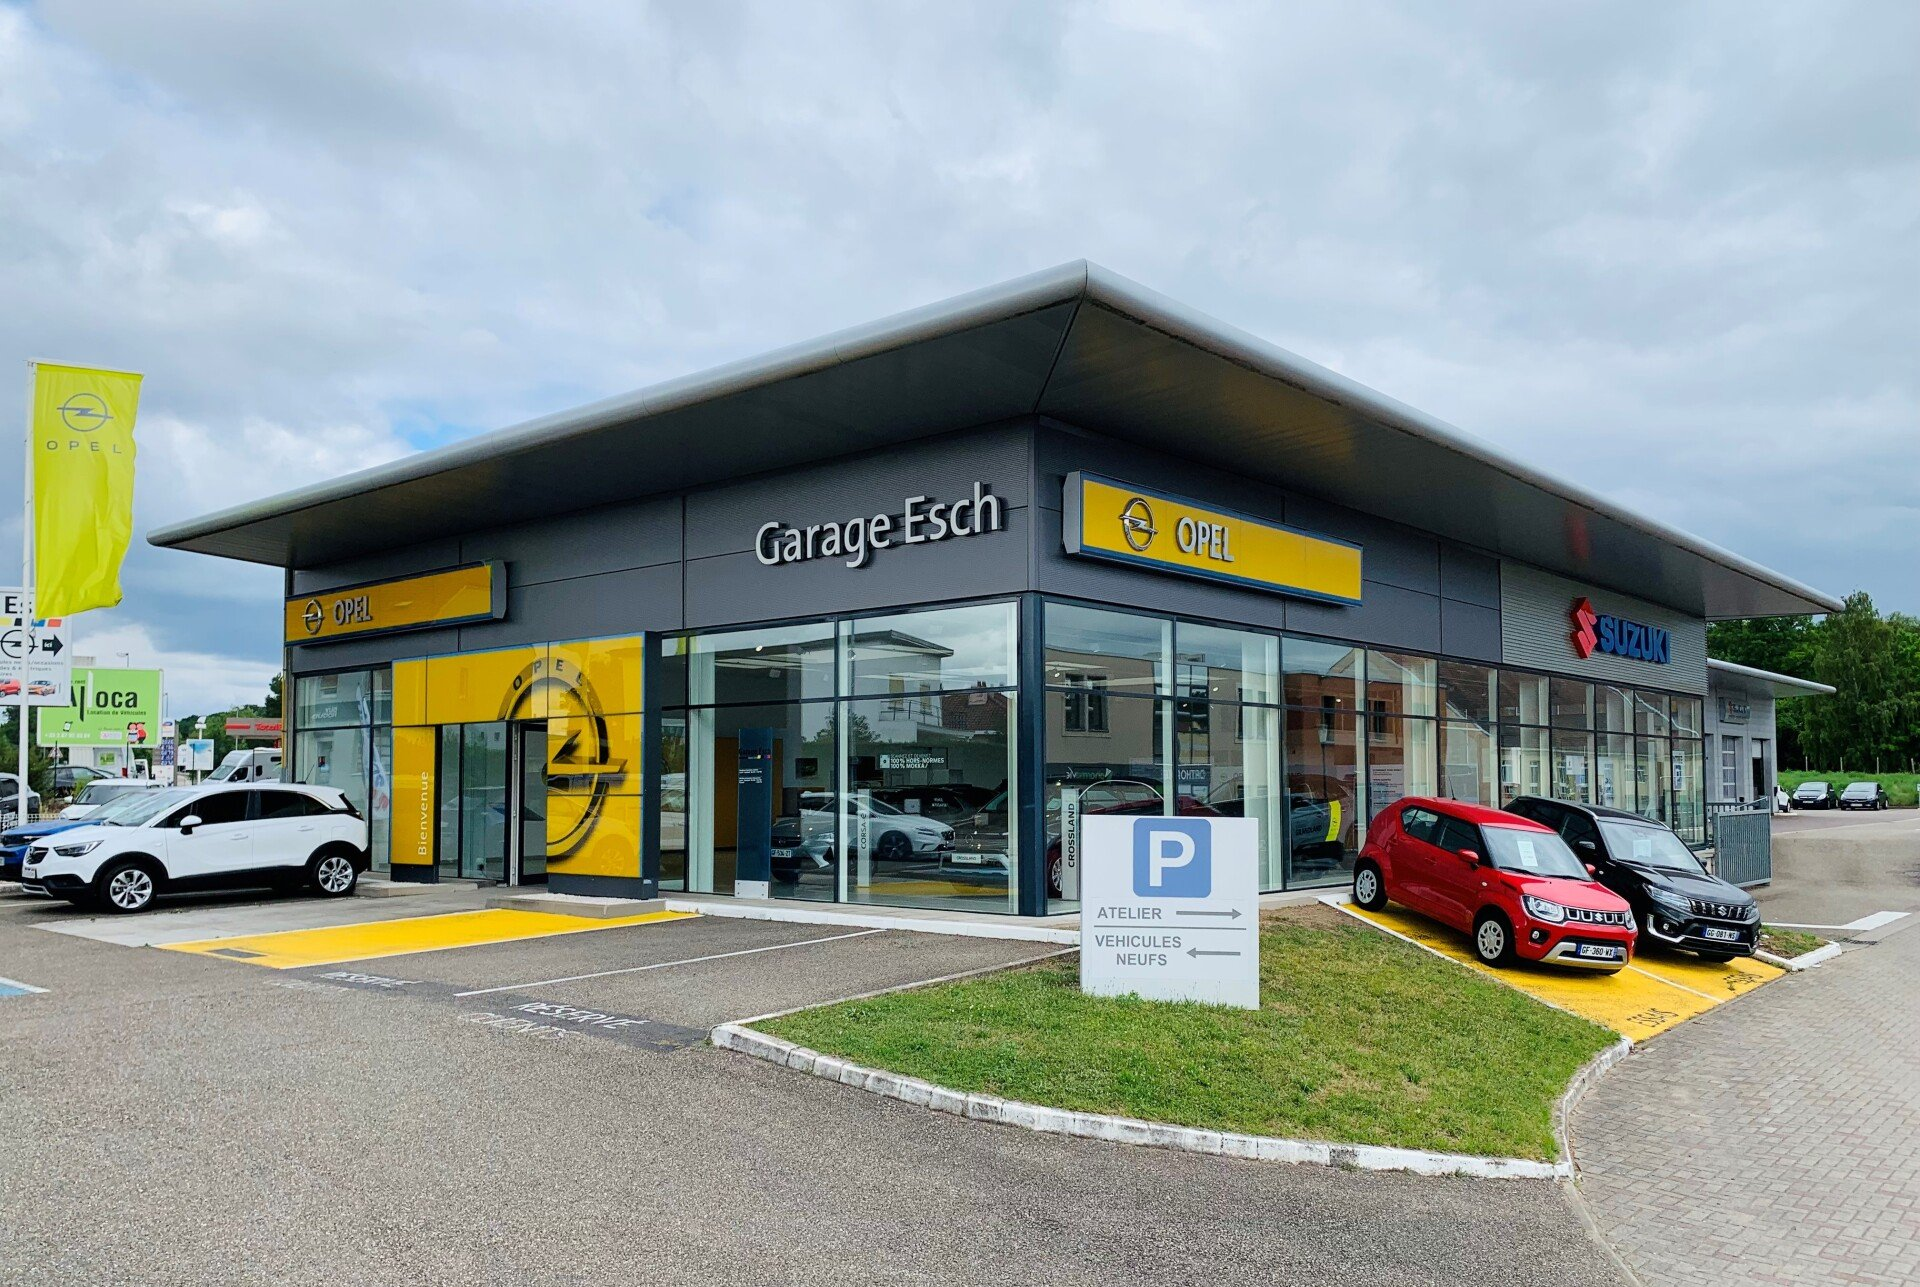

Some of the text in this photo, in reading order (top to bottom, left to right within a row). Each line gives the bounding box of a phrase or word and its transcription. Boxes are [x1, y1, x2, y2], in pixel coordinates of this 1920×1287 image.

[47, 440, 122, 454] OPEL
[755, 481, 1000, 568] Garage Esch
[1176, 515, 1235, 562] OPEL
[333, 596, 373, 626] OPEL
[1599, 614, 1672, 664] SUZUKI
[513, 657, 584, 690] OPEL
[417, 770, 429, 856] Bienvenue
[1067, 803, 1076, 868] CROSSLAND
[1149, 830, 1196, 887] P
[1097, 906, 1162, 920] ATELIER
[1095, 934, 1182, 949] VEHICULES
[1116, 952, 1167, 966] NEUFS
